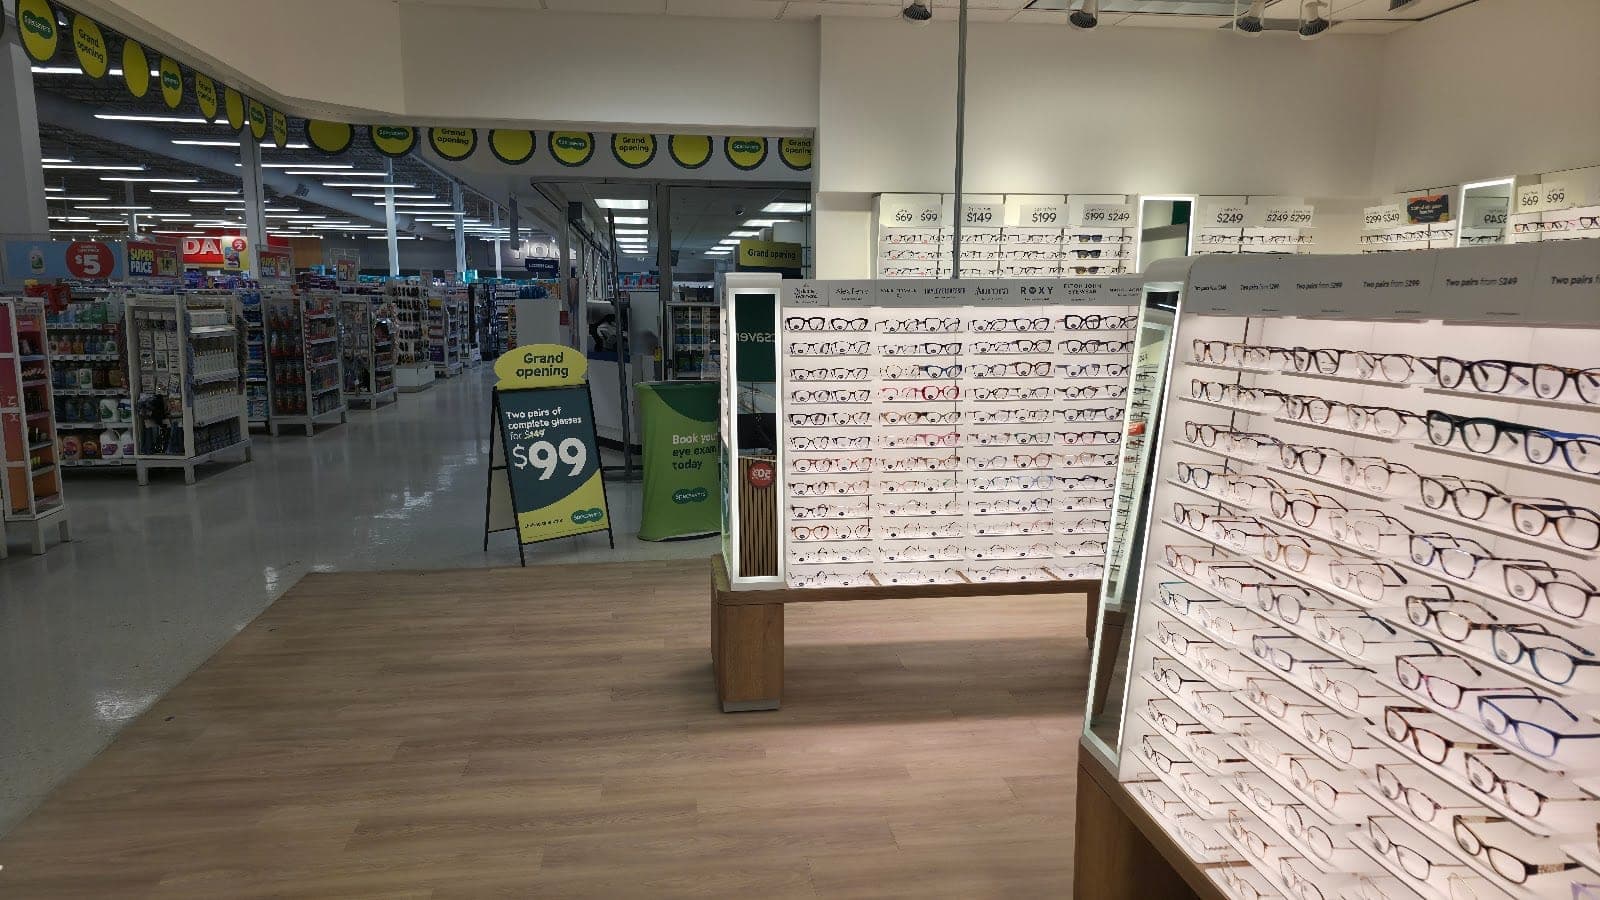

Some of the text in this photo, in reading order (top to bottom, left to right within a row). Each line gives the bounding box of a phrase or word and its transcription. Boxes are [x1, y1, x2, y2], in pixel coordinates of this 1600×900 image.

[78, 28, 99, 47] Grand
[77, 41, 104, 64] opening
[441, 128, 466, 136] Grand
[437, 136, 469, 145] opening
[622, 136, 645, 144] Grand
[788, 139, 811, 147] Grand
[619, 144, 649, 152] opening
[1521, 195, 1539, 206] $69
[1546, 192, 1565, 203] $99
[895, 212, 913, 222] $69
[920, 212, 938, 222] $99
[966, 211, 992, 223] $149
[1031, 211, 1057, 223] $199
[1085, 212, 1105, 221] $199
[1108, 212, 1130, 221] $249
[1216, 212, 1243, 223] $249
[1267, 213, 1288, 222] $249
[1290, 214, 1311, 222] $299
[1365, 214, 1382, 224] $299
[1383, 213, 1400, 223] $349
[130, 247, 154, 261] SUPER
[748, 248, 796, 260] Grand opening
[130, 261, 153, 274] PRICE
[1375, 280, 1390, 289] pairs
[1446, 278, 1460, 286] Two
[1460, 277, 1479, 287] pairs
[1551, 276, 1569, 284] Two
[1570, 274, 1593, 286] pairs
[1020, 286, 1054, 295] ROXY
[523, 352, 564, 365] Grand
[516, 364, 569, 379] opening
[506, 406, 562, 420] Two pairs of
[508, 417, 582, 431] complete glasses
[510, 431, 522, 440] for
[672, 433, 699, 445] Book
[672, 445, 717, 458] eye exam
[512, 437, 587, 481] $99
[672, 459, 703, 470] today
